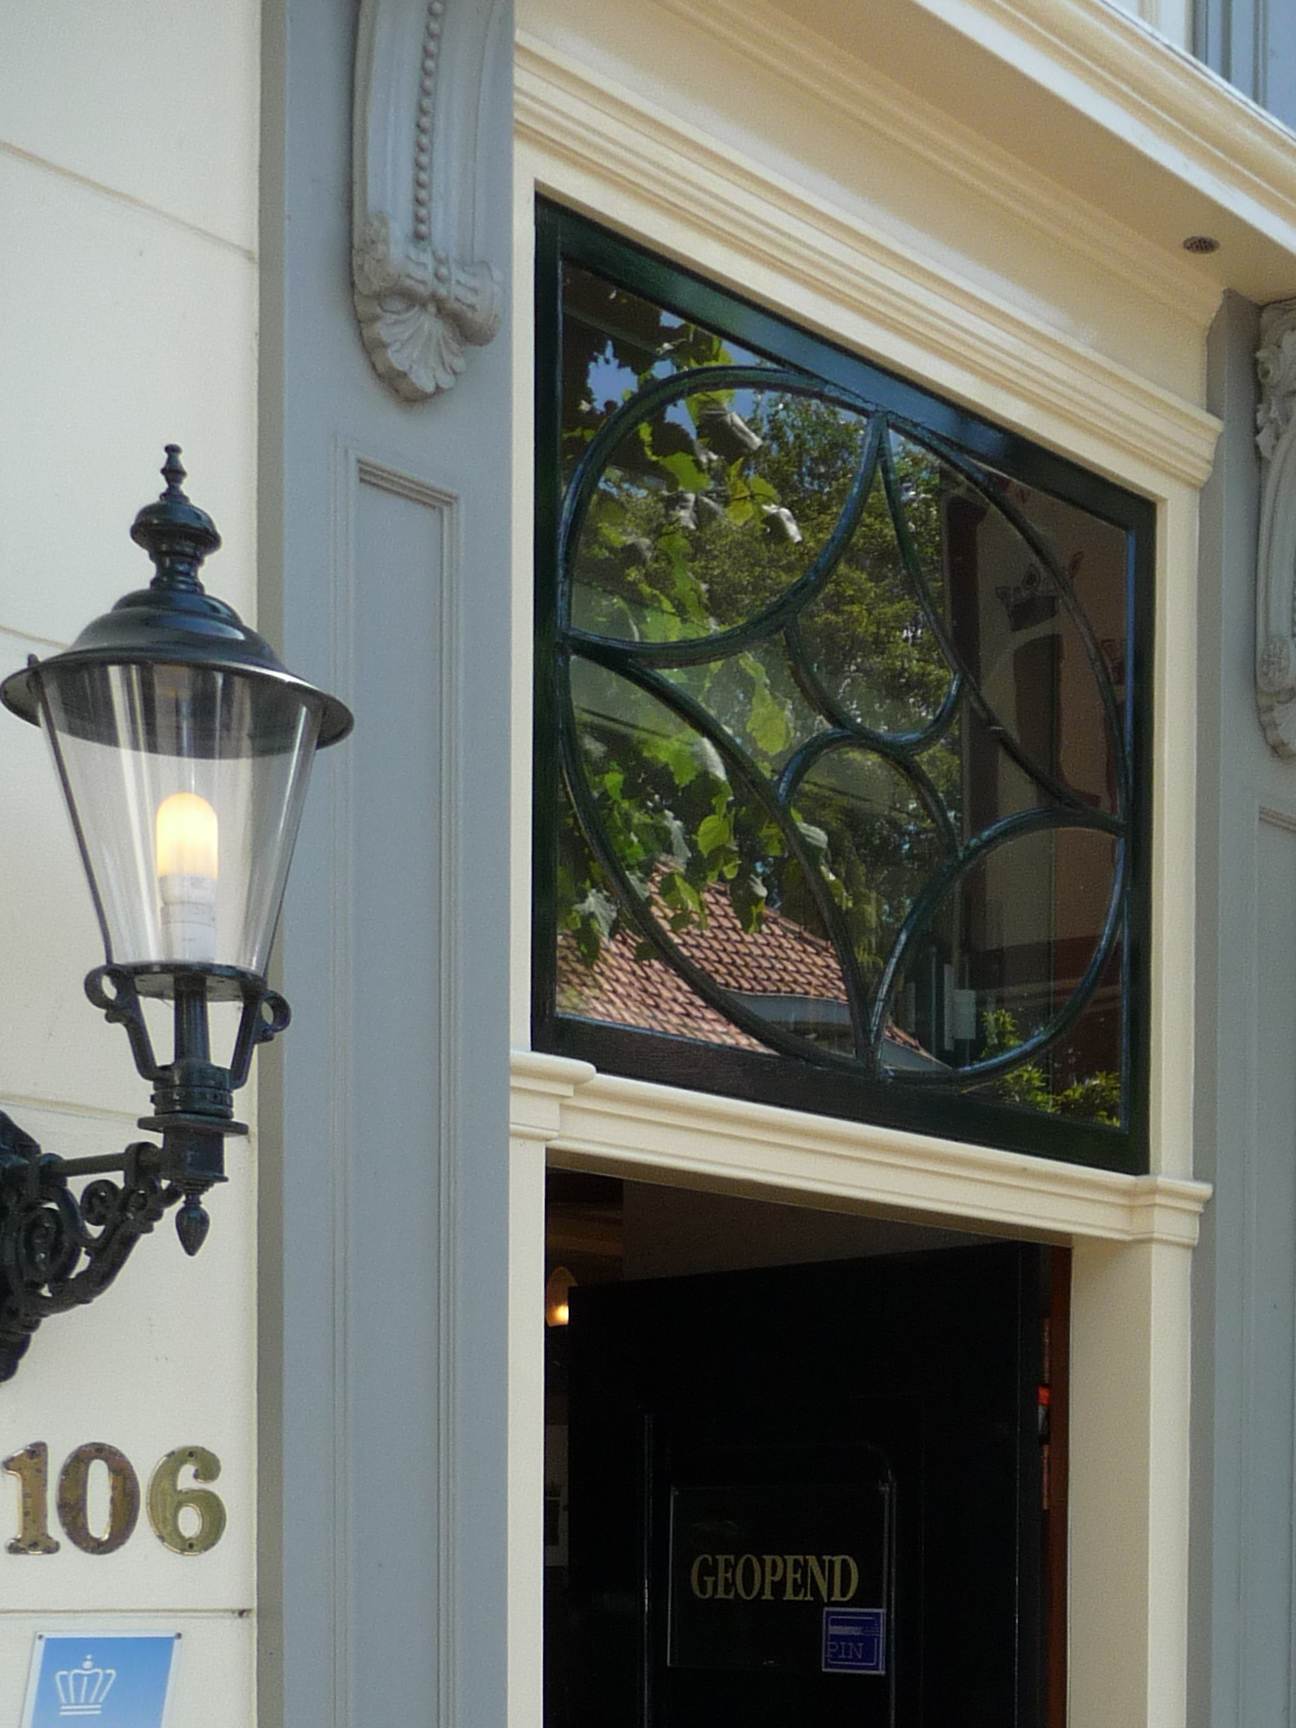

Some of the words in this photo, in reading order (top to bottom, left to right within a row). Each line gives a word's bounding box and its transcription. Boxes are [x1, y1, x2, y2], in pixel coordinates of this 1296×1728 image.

[2, 1441, 227, 1557] 106
[690, 1553, 860, 1603] GEOPEND
[825, 1640, 865, 1660] PIN
